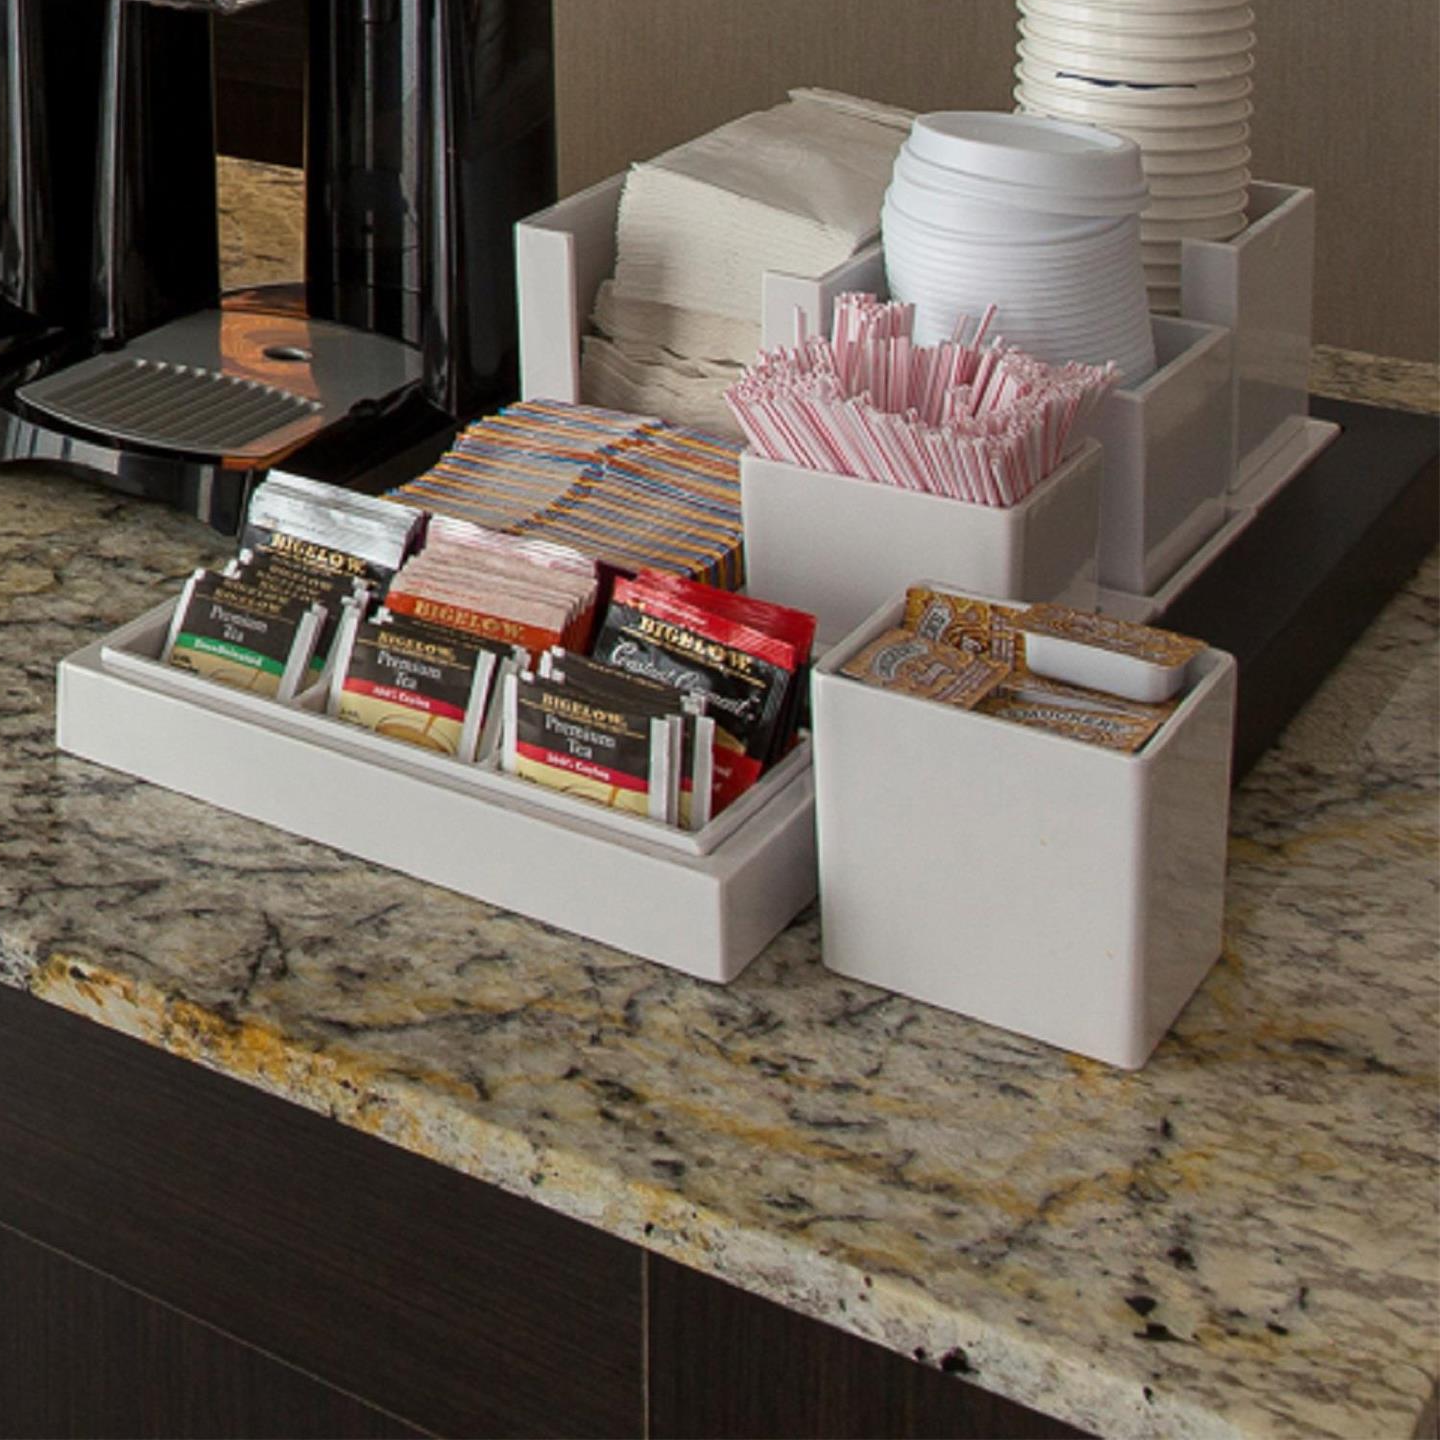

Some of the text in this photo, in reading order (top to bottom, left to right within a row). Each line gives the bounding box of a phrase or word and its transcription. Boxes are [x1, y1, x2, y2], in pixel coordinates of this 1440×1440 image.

[210, 605, 268, 633] Premium
[378, 650, 442, 679] Premium
[395, 671, 418, 690] Tea
[545, 714, 617, 748] Premium
[567, 737, 593, 759] Tea
